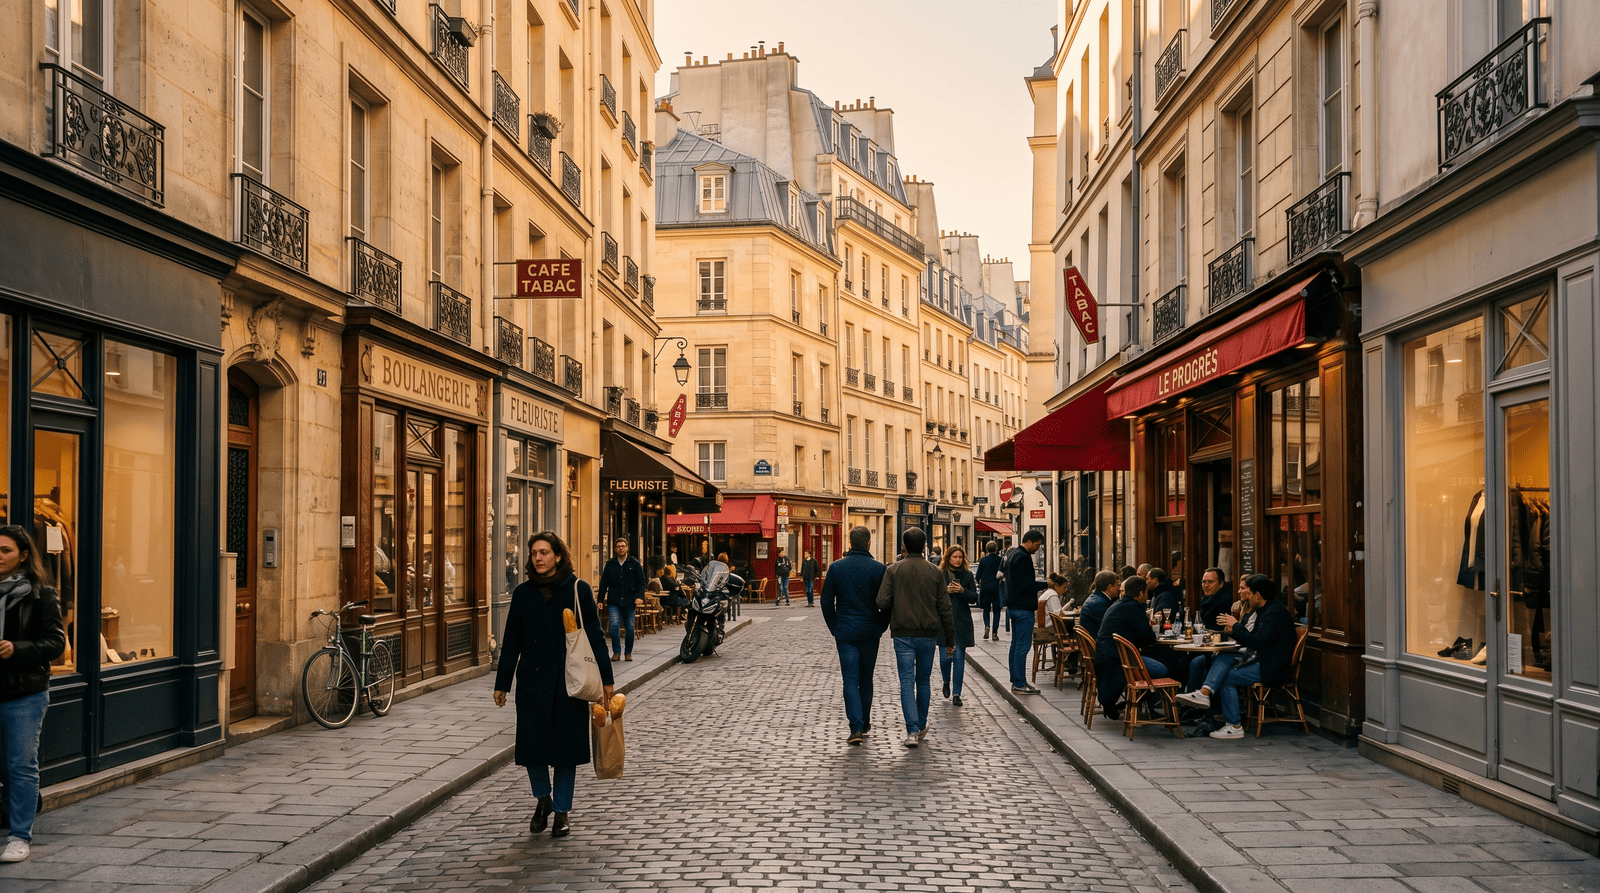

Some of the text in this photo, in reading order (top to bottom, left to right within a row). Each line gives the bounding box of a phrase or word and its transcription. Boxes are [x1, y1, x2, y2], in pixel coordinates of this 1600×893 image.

[527, 263, 571, 277] CAFE
[521, 279, 576, 293] TABAC
[1068, 275, 1095, 334] TABAC
[382, 354, 471, 409] BOULANGERIE
[1158, 371, 1170, 396] LE
[510, 396, 559, 434] FLEURISTE
[609, 480, 669, 490] FLEURISTE
